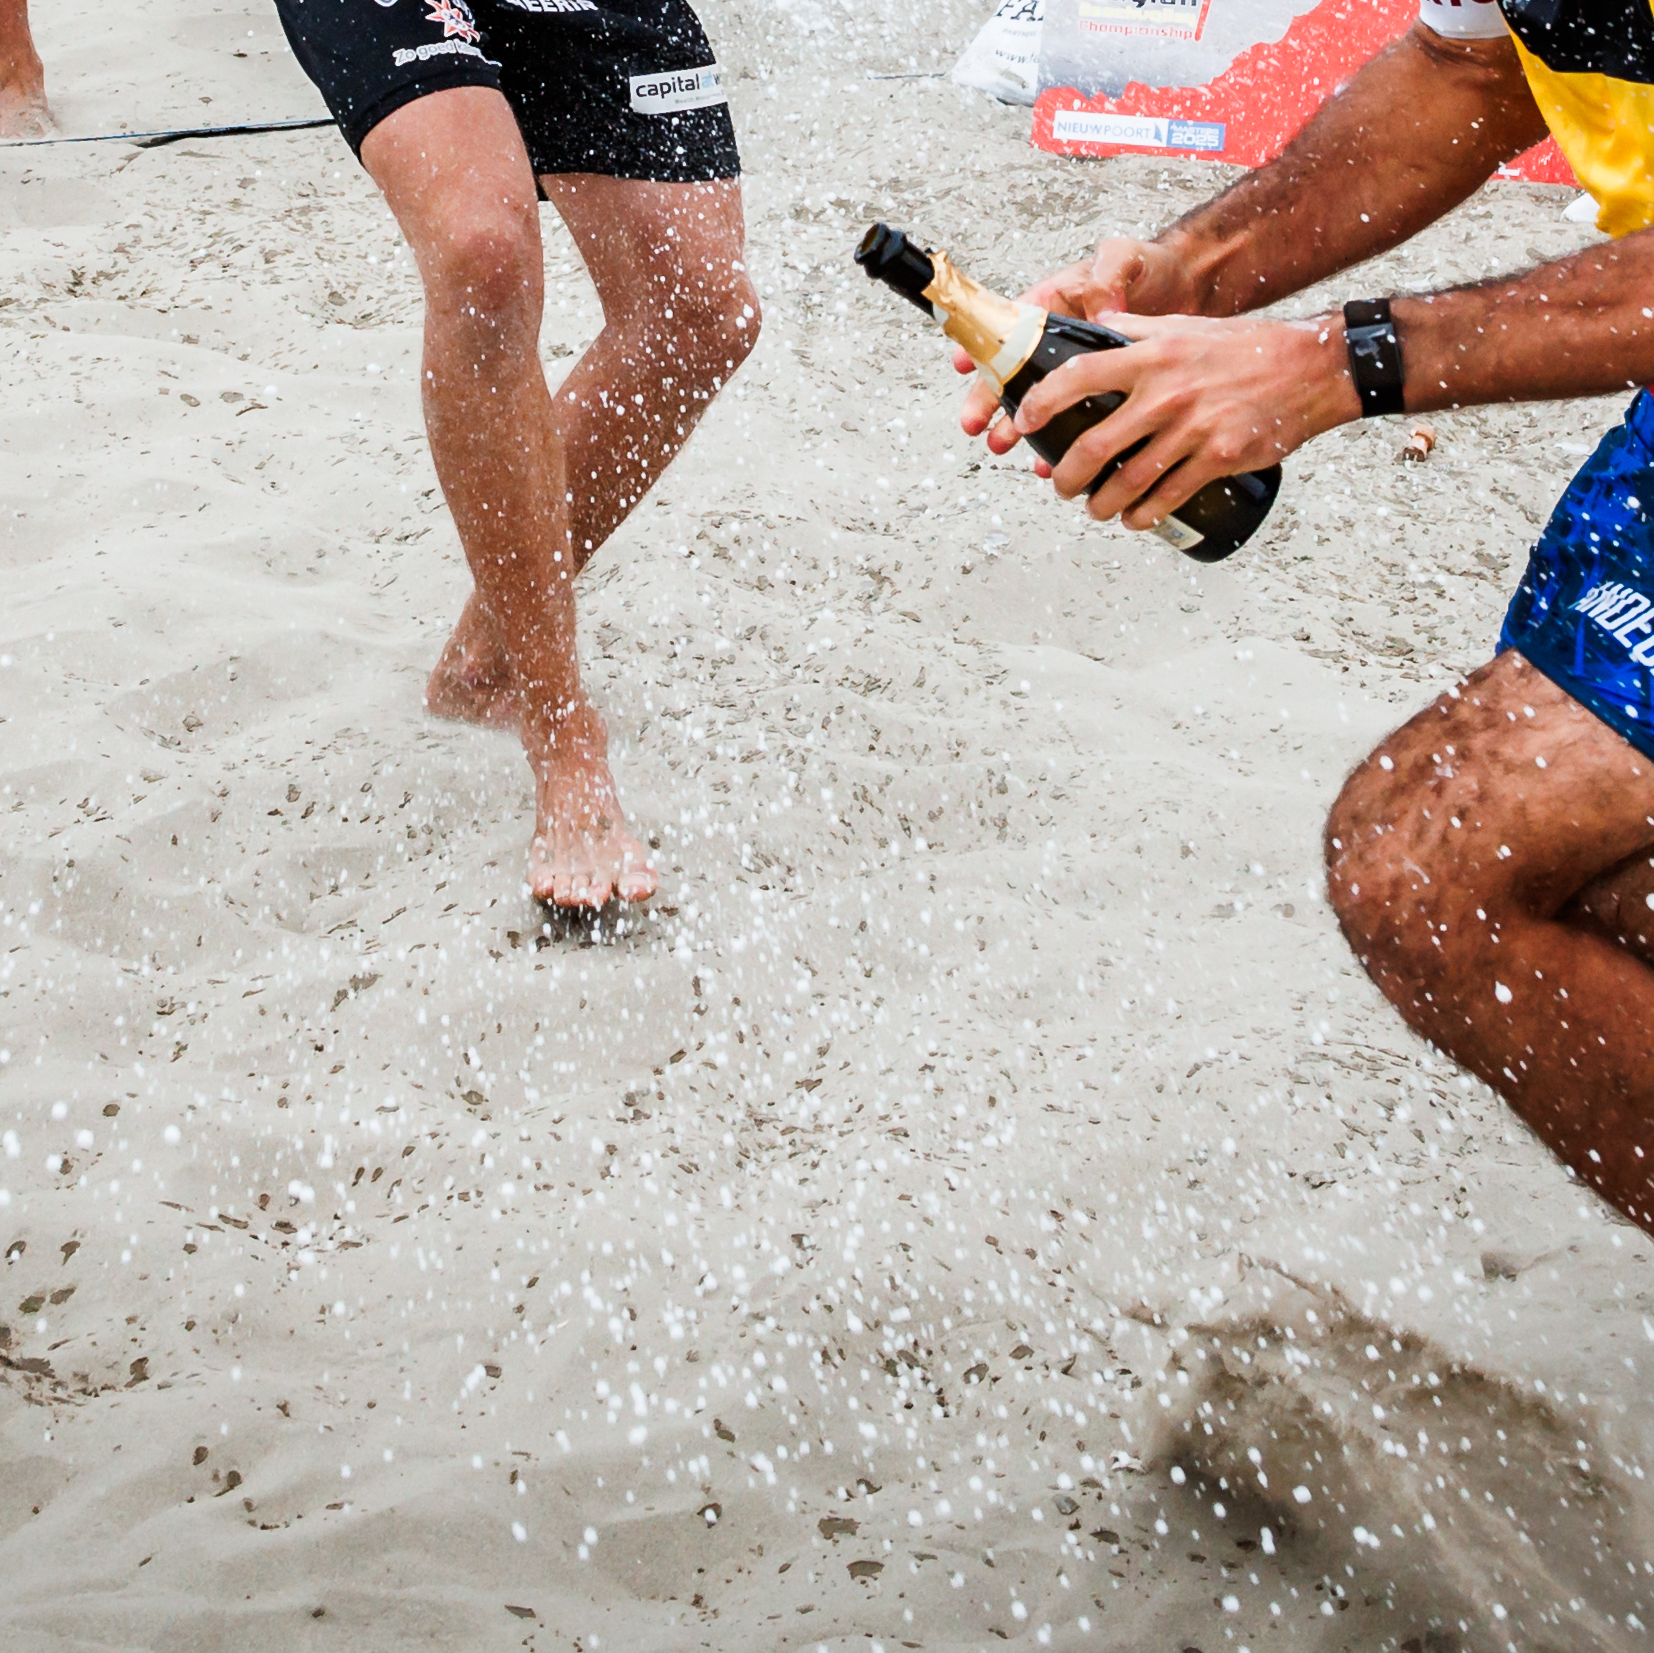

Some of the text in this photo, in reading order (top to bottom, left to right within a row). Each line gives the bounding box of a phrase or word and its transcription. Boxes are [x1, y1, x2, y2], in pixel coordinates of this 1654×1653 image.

[1079, 20, 1193, 40] Championship
[1057, 121, 1151, 140] NIEUWPOORT
[1170, 133, 1219, 147] 2025
